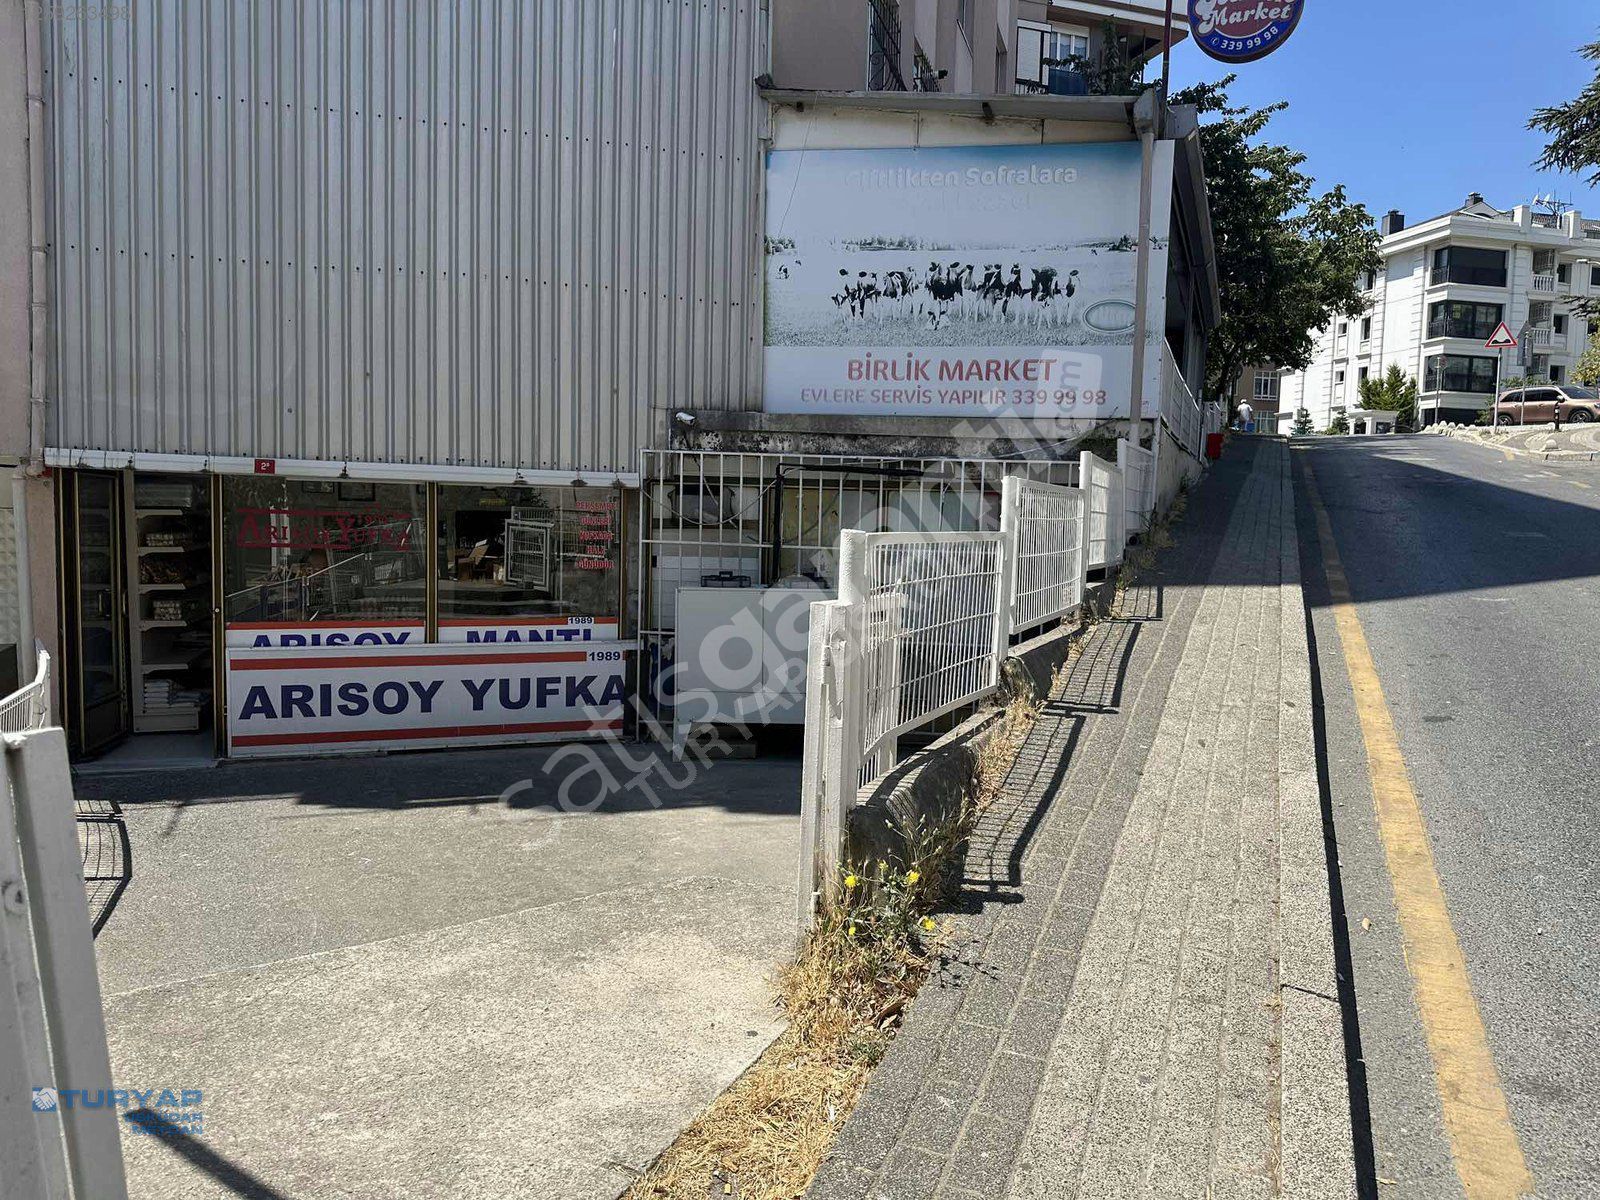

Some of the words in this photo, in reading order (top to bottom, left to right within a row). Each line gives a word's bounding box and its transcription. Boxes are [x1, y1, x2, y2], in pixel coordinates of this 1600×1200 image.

[1198, 2, 1291, 33] Market
[1221, 39, 1243, 50] 339
[1246, 37, 1262, 49] 99
[1264, 26, 1279, 40] 98
[964, 165, 1078, 187] Sofralara
[847, 352, 932, 381] BİRLİK
[938, 358, 1057, 382] MARKET
[800, 388, 865, 403] EVLERE
[870, 385, 932, 404] SERVİS
[938, 389, 1006, 405] YAPILIR
[1012, 390, 1048, 405] 339
[1053, 390, 1077, 405] 99
[1082, 390, 1107, 405] 98
[588, 651, 621, 661] 1989
[238, 680, 442, 720] ARISOY
[461, 674, 626, 711] YUFKA
